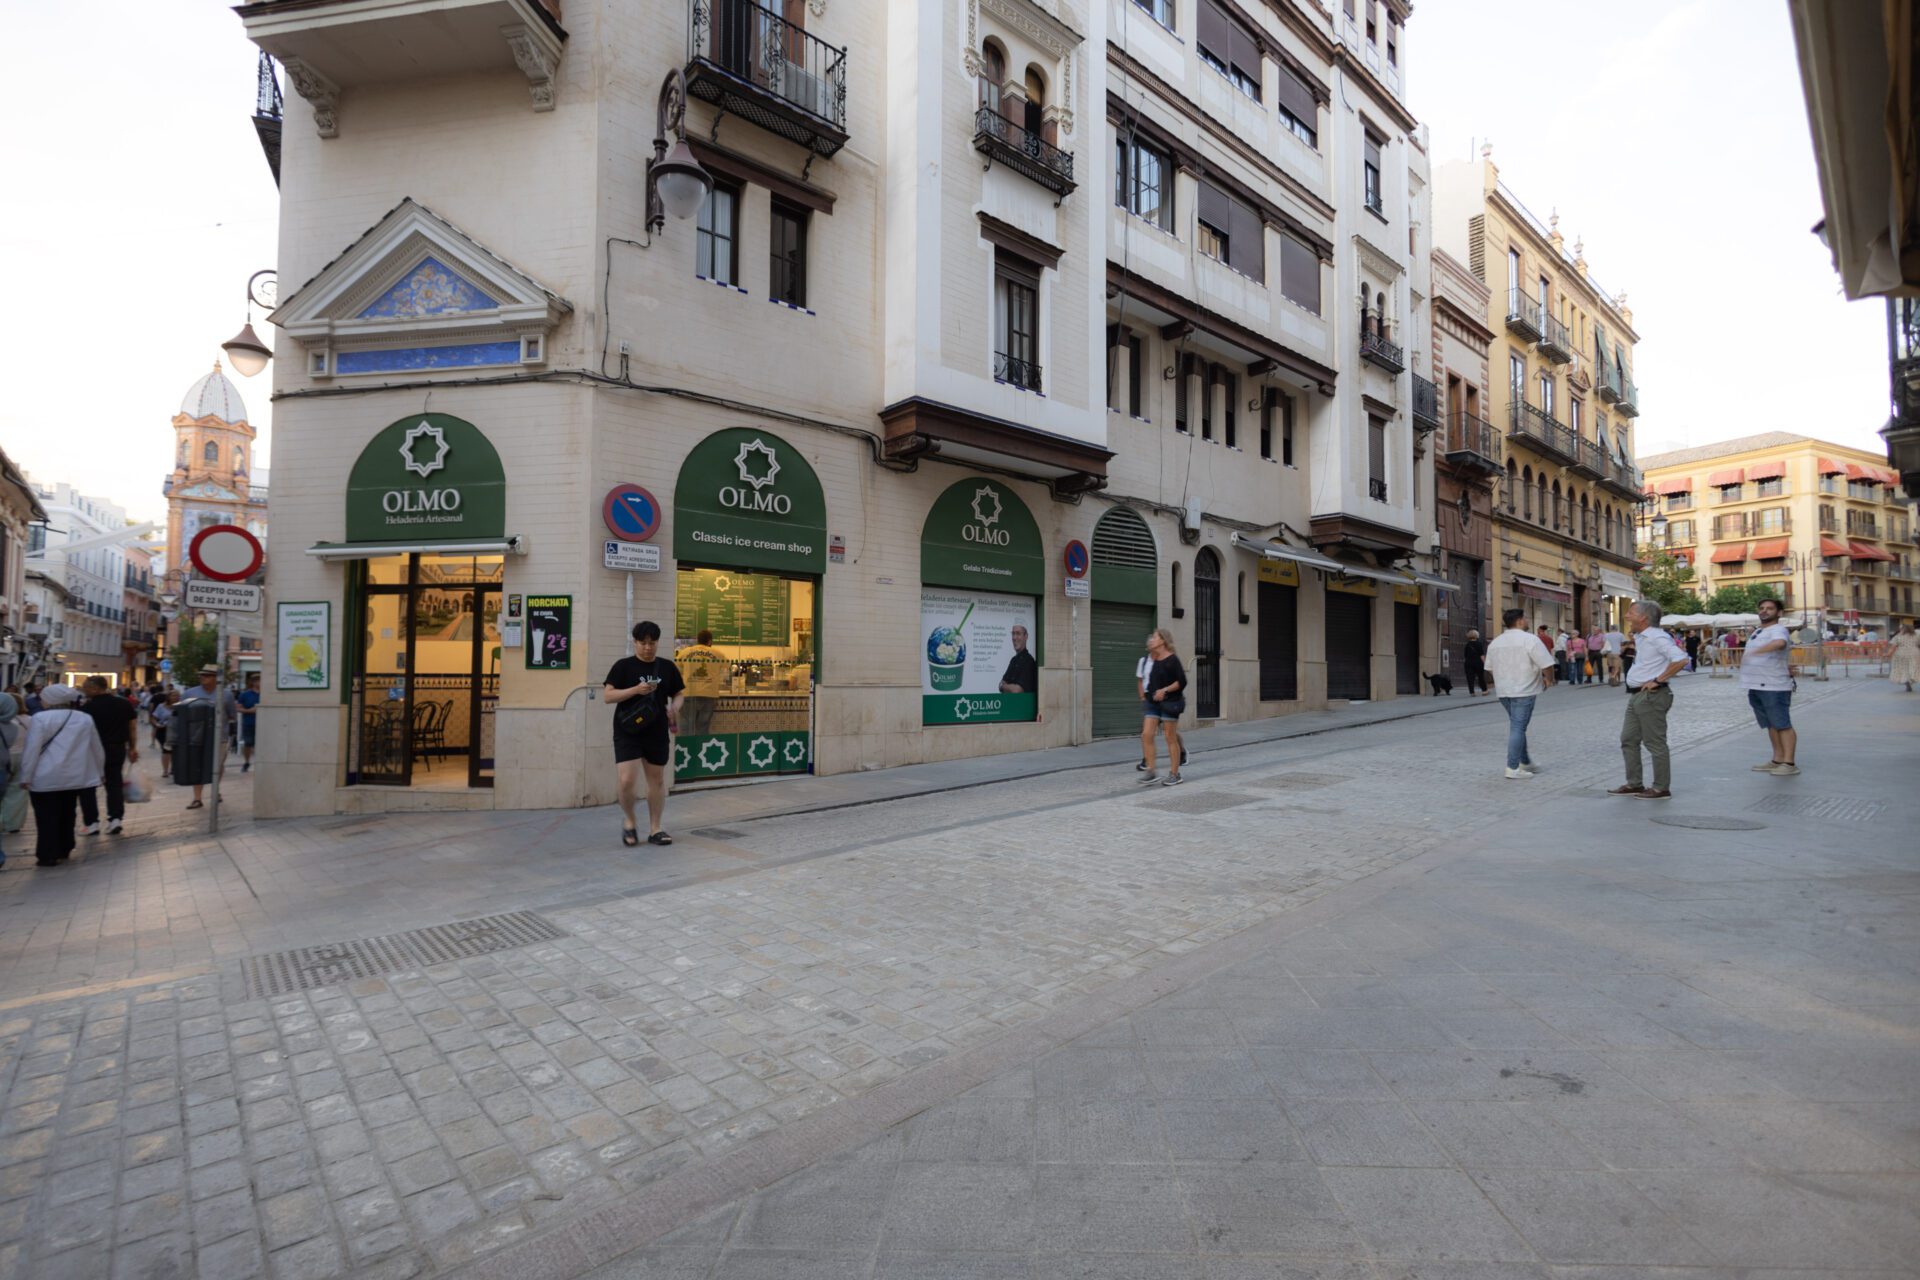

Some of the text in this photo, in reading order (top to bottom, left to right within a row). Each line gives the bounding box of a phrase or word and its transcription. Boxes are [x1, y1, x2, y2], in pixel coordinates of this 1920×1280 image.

[382, 488, 461, 513] OLMO
[718, 486, 792, 515] OLMO
[385, 513, 463, 525] Heladería Artesanal
[961, 524, 1010, 546] OLMO
[692, 530, 812, 556] Classic ice cream shop
[963, 563, 981, 573] Gelato
[190, 585, 254, 597] EXCEPTO CICLOS
[193, 595, 204, 604] DE
[205, 596, 216, 604] 22
[217, 597, 223, 605] H
[528, 597, 570, 608] HORCHATA
[971, 699, 1002, 711] OLMO
